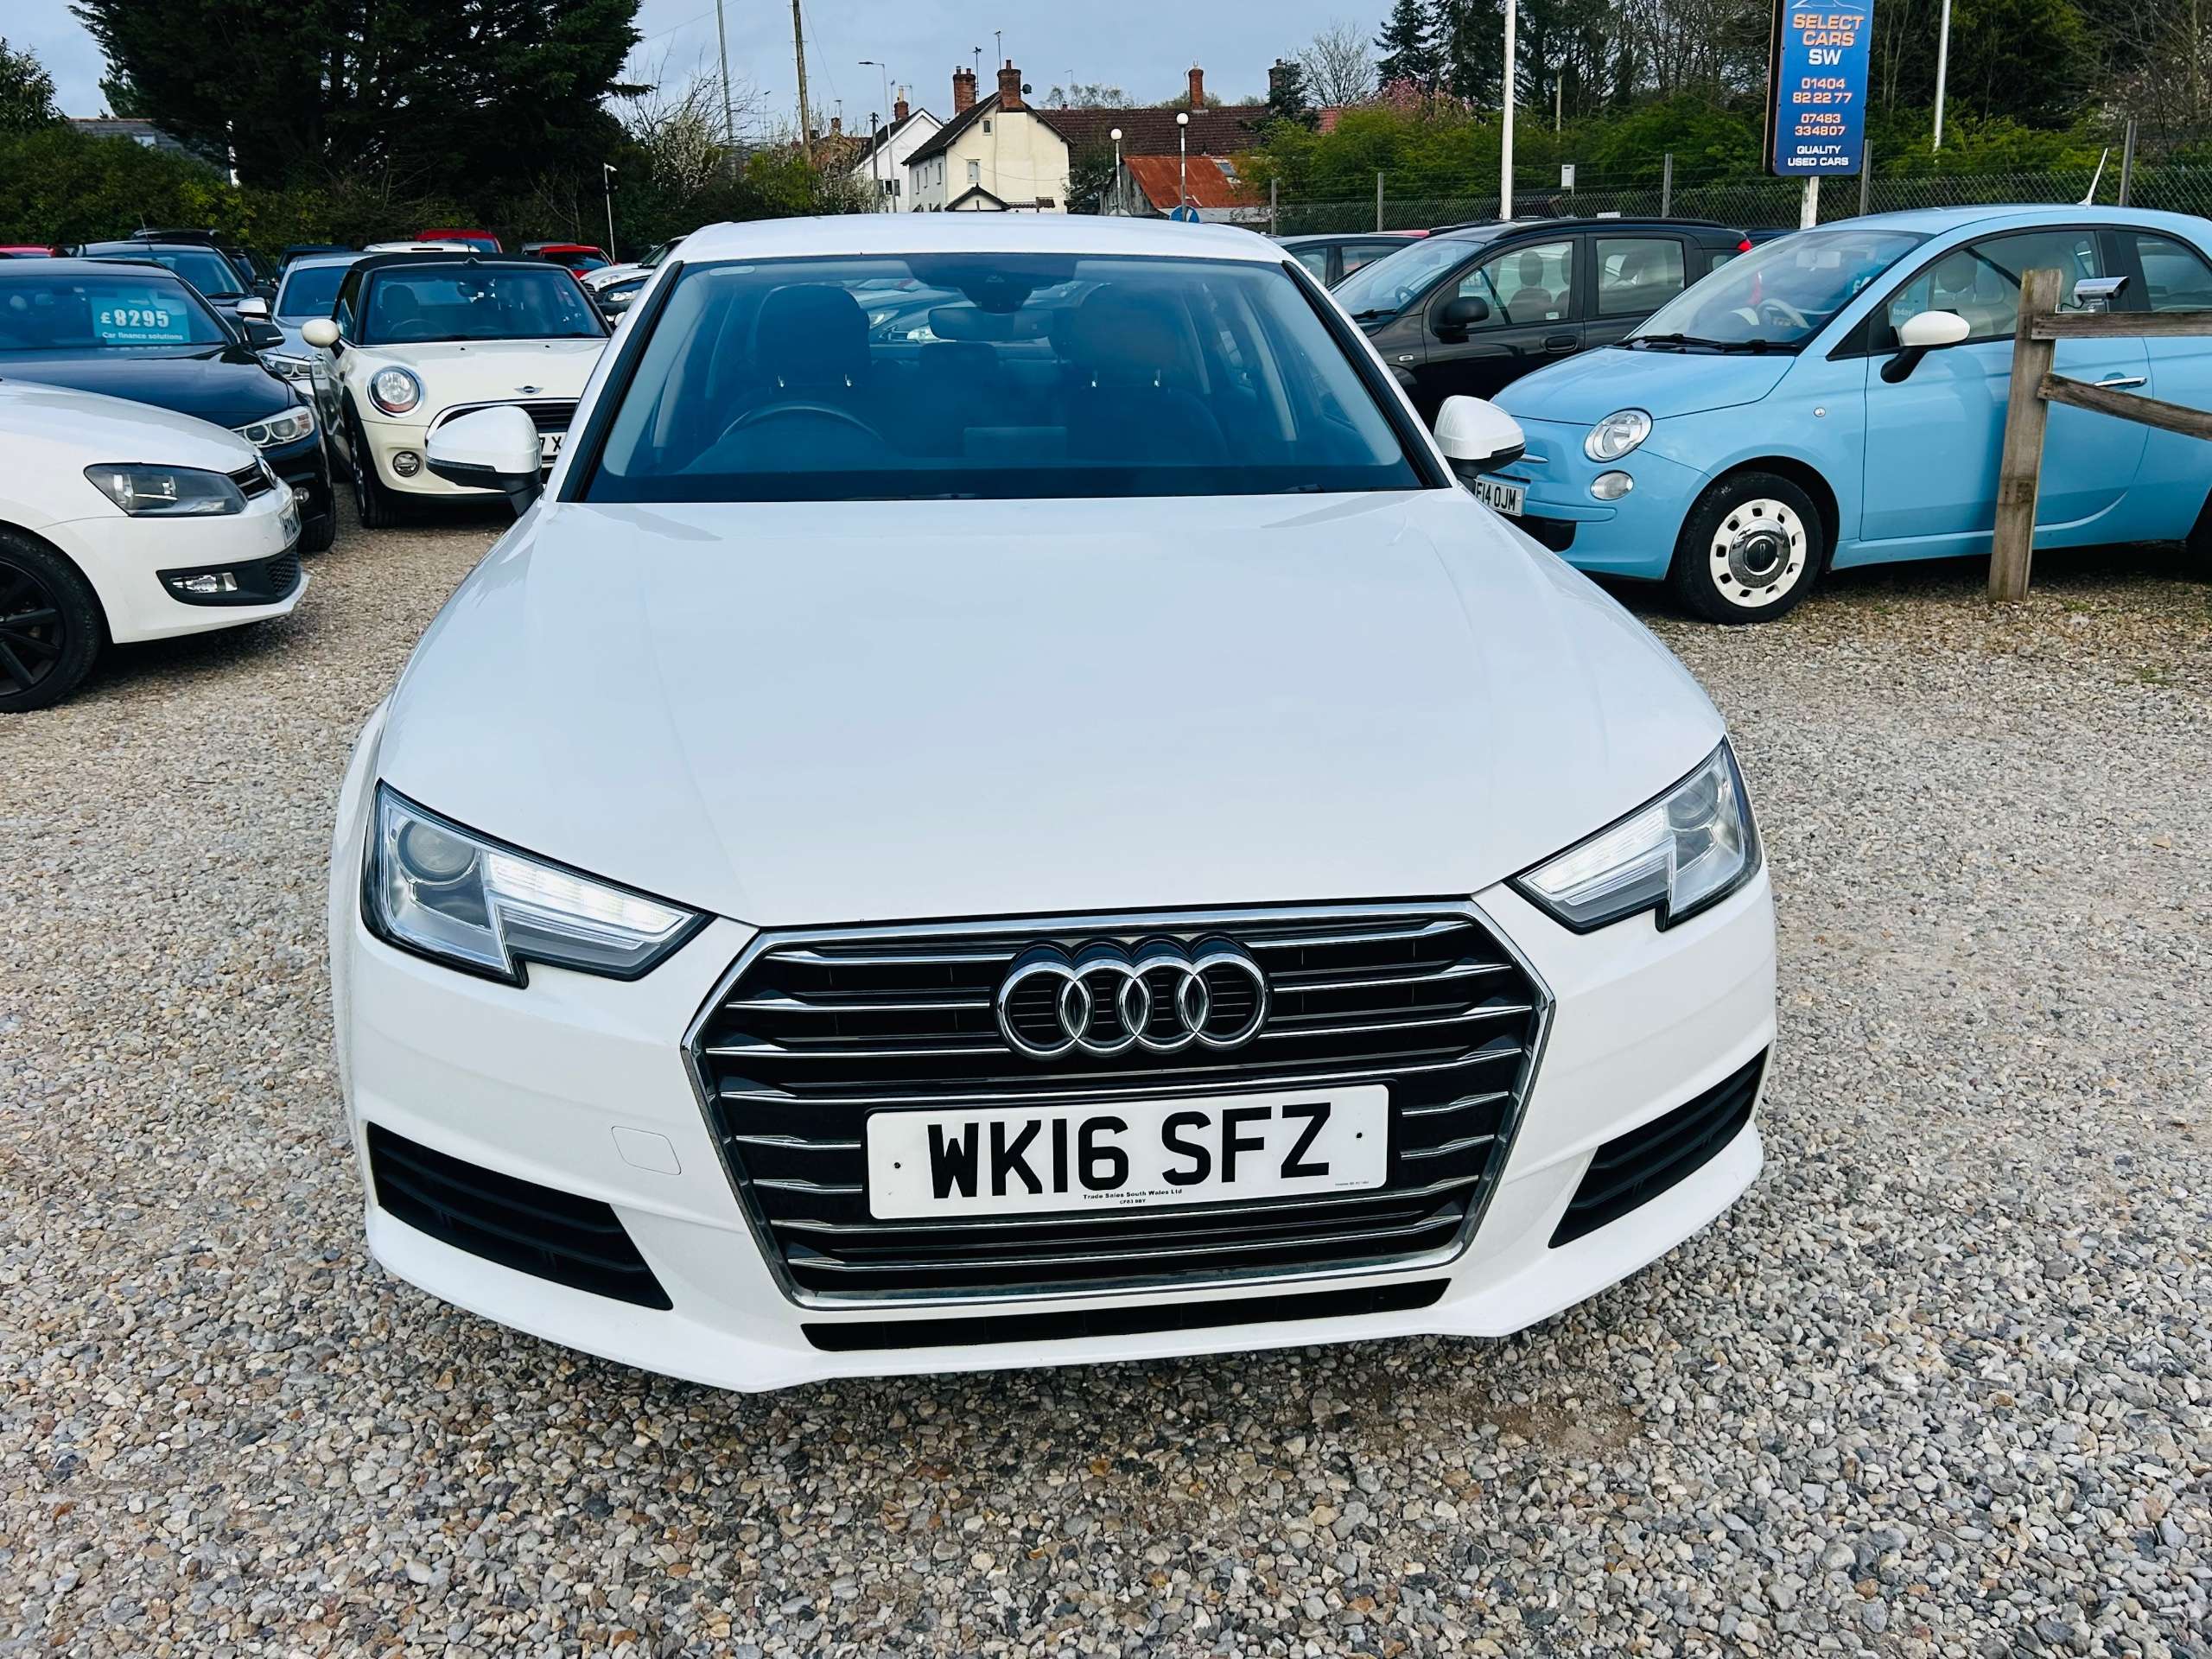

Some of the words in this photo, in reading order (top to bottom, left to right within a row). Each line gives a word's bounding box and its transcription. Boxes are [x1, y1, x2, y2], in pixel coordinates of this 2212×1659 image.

[1792, 13, 1865, 31] SELECT
[1802, 29, 1855, 47] CARS
[1808, 49, 1842, 66] SW
[1801, 77, 1846, 89] 01404
[1801, 113, 1841, 124] 07483
[1795, 125, 1846, 136] 334807
[1796, 145, 1842, 155] QUALITY
[1788, 156, 1817, 167] USED
[1819, 157, 1849, 167] CARS
[1494, 486, 1516, 512] OJM
[927, 1116, 1129, 1199] WK16
[1160, 1102, 1332, 1186] SFZ
